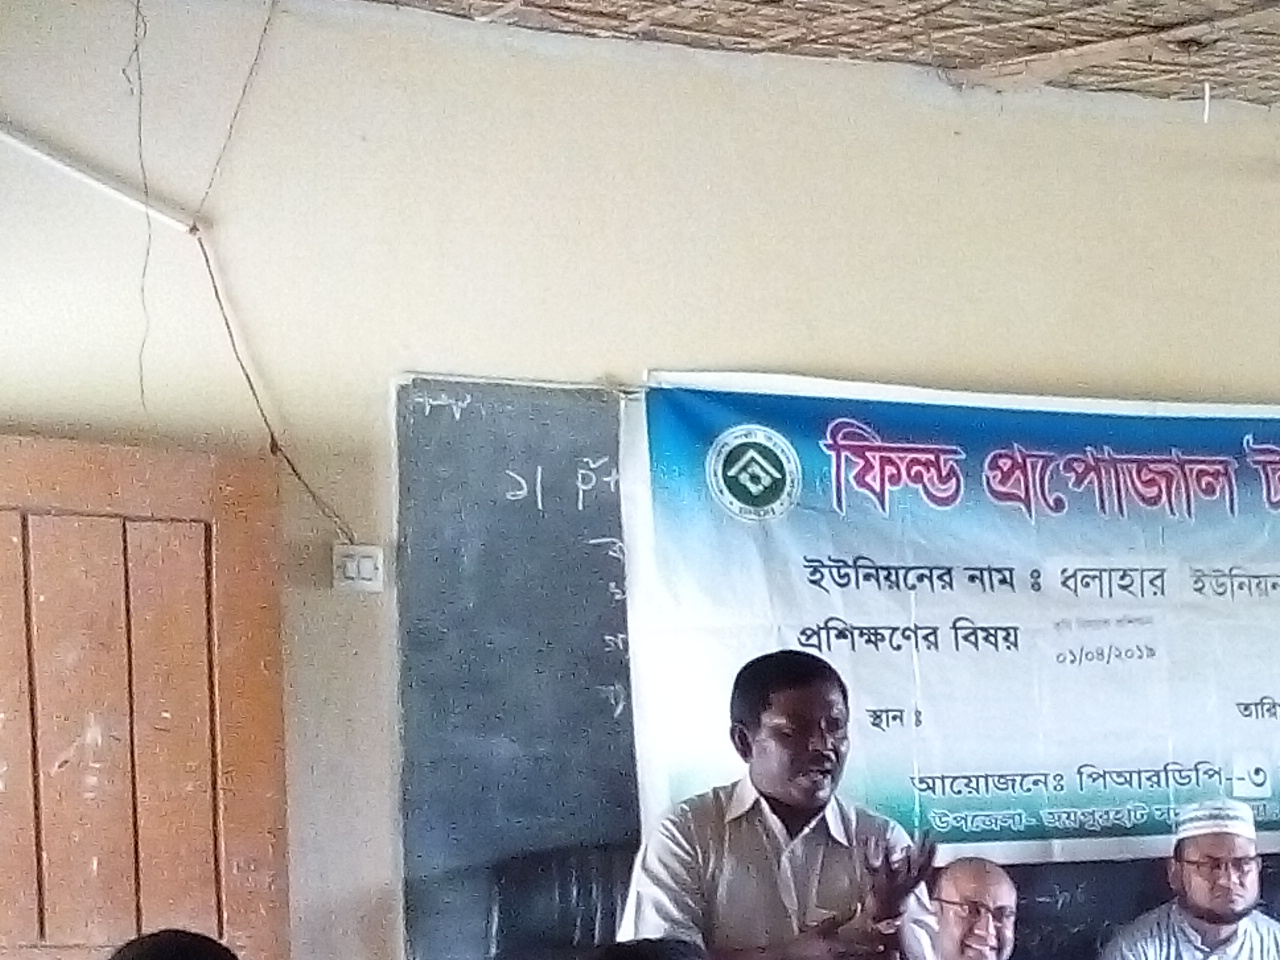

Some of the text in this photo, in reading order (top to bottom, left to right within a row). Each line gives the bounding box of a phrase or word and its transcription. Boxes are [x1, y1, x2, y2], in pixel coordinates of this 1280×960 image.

[821, 418, 966, 517] ফিল্ড
[983, 441, 1240, 527] প্রপোজাল
[803, 556, 954, 594] ইউনিয়নের
[965, 565, 1015, 593] নাম
[1060, 565, 1168, 598] ধলাহার
[797, 617, 940, 653] প্রশিক্ষণের
[951, 616, 1021, 650] বিষয়
[864, 707, 906, 733] স্থান
